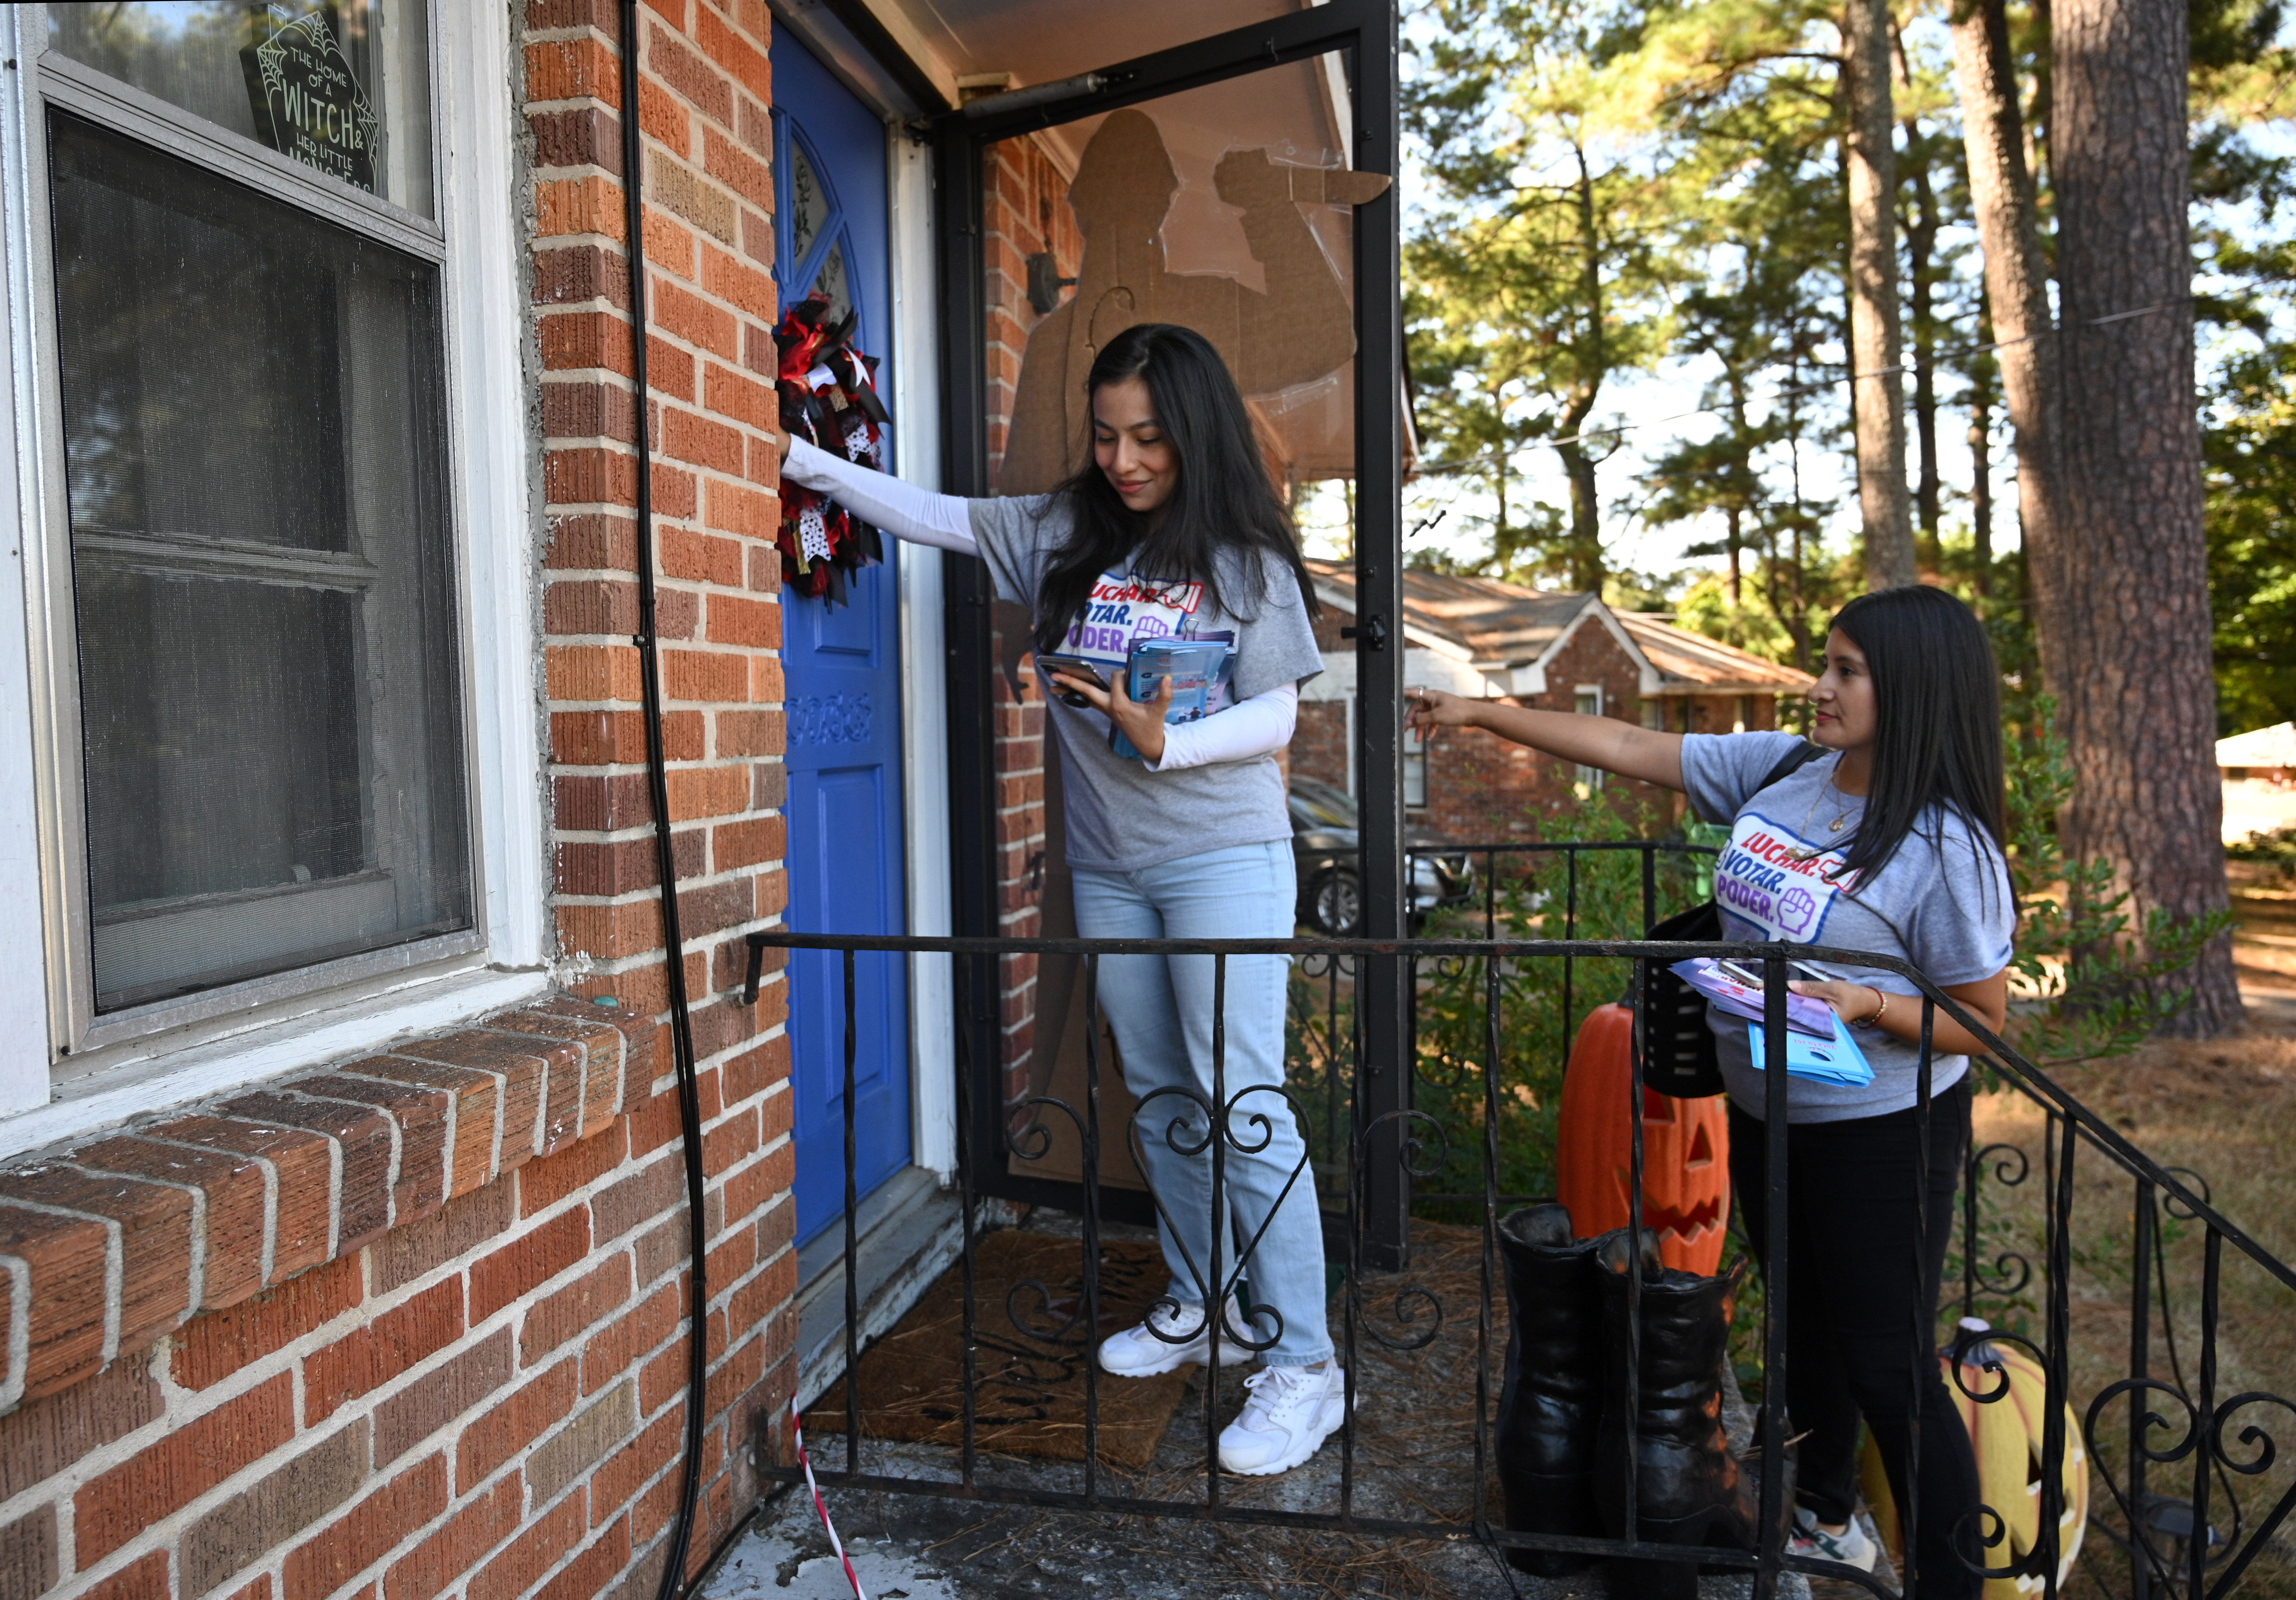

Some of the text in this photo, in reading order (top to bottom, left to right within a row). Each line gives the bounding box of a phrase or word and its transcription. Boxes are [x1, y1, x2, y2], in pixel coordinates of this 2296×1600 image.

[290, 46, 347, 87] THE HOME
[308, 74, 332, 97] OF A
[282, 78, 363, 150] WITCH &
[297, 132, 317, 157] HER
[1068, 625, 1128, 654] ODER.
[1723, 849, 1786, 894] VOTAR.
[1740, 832, 1820, 877] LUCHAR.
[1717, 873, 1774, 923] PODER.
